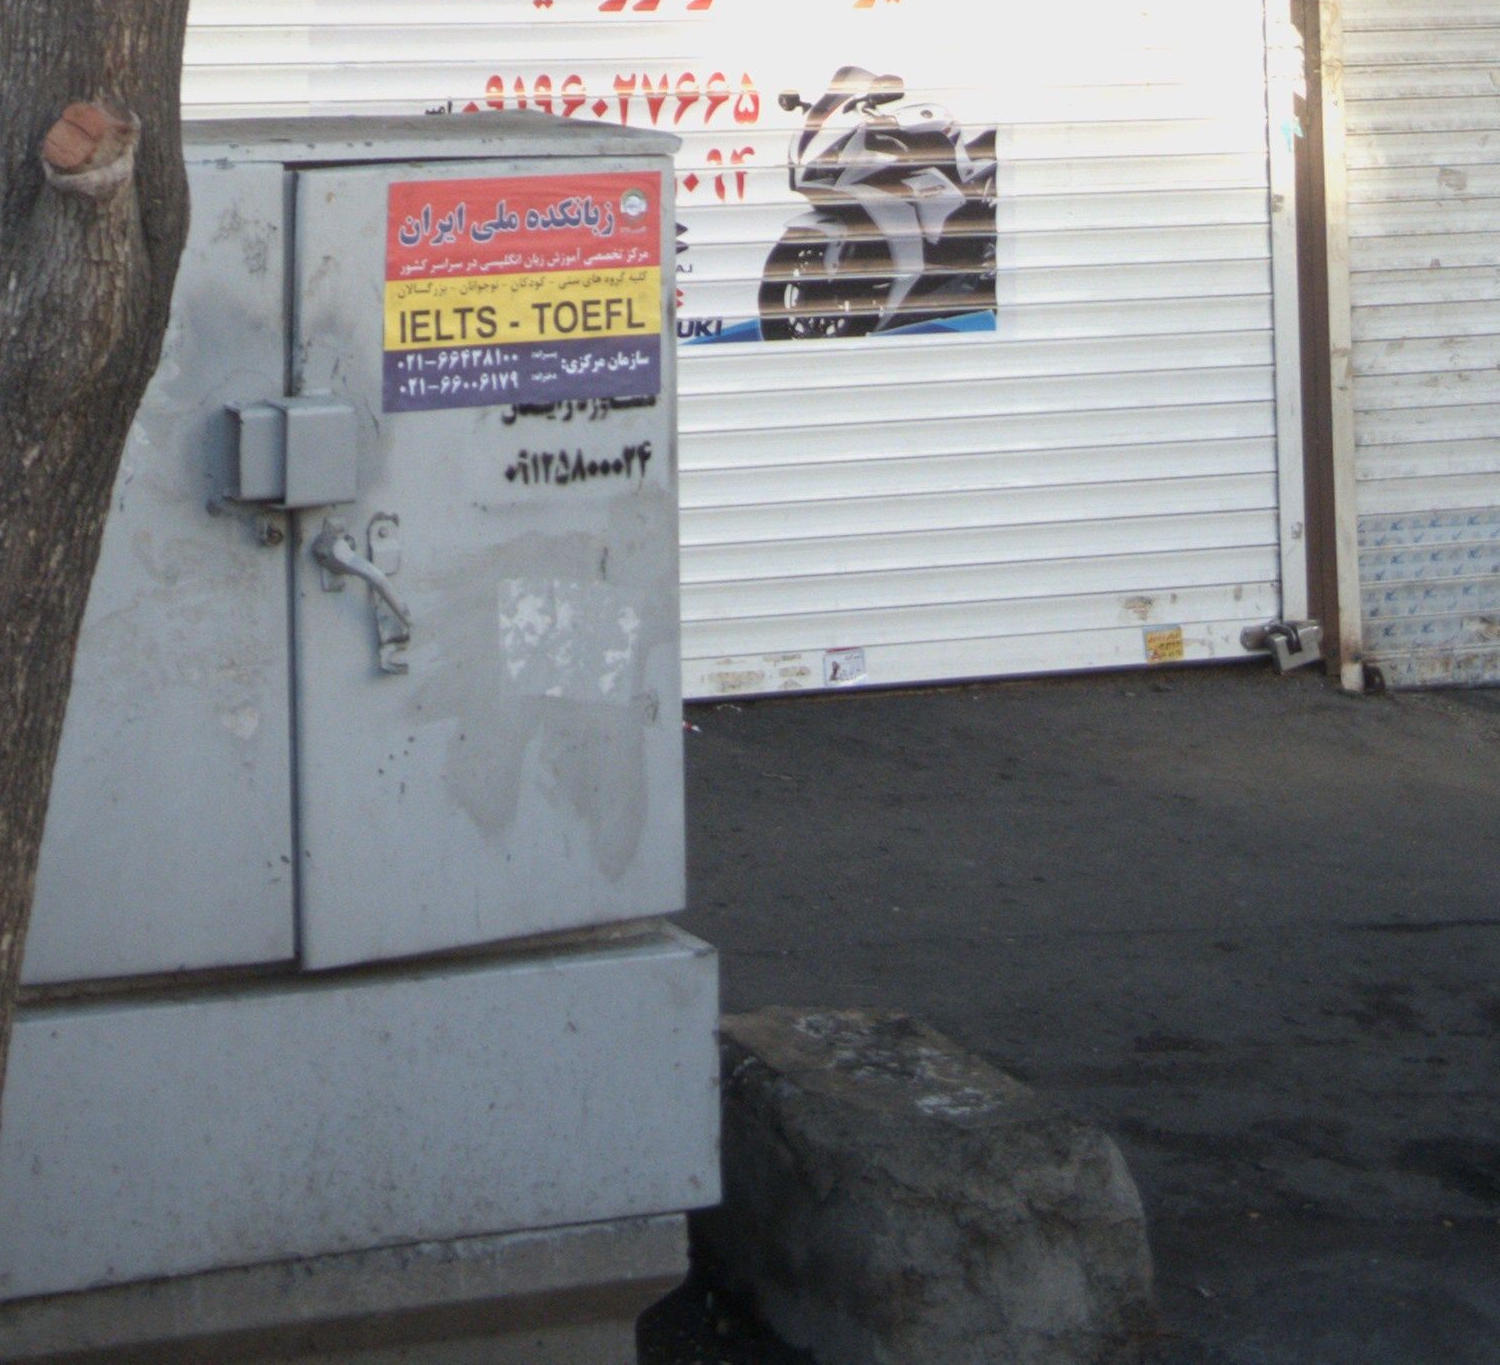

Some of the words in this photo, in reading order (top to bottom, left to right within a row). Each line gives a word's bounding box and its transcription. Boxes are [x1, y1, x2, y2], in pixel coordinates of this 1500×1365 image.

[398, 201, 467, 246] ایران
[470, 198, 520, 243] ملی
[524, 195, 615, 237] زبانکده
[430, 257, 463, 273] سراسر
[480, 253, 522, 271] انگلیسی
[523, 253, 545, 268] زبان
[546, 246, 581, 267] آموزش
[583, 248, 623, 265] تخصصی
[626, 247, 649, 263] مرکز
[399, 258, 428, 275] کشور
[400, 305, 497, 344] IELTS
[531, 297, 646, 335] TOEFL
[607, 350, 650, 371] سازمان
[399, 370, 518, 396] ۰۲۱-۶۶۰۰۶۱۷۹
